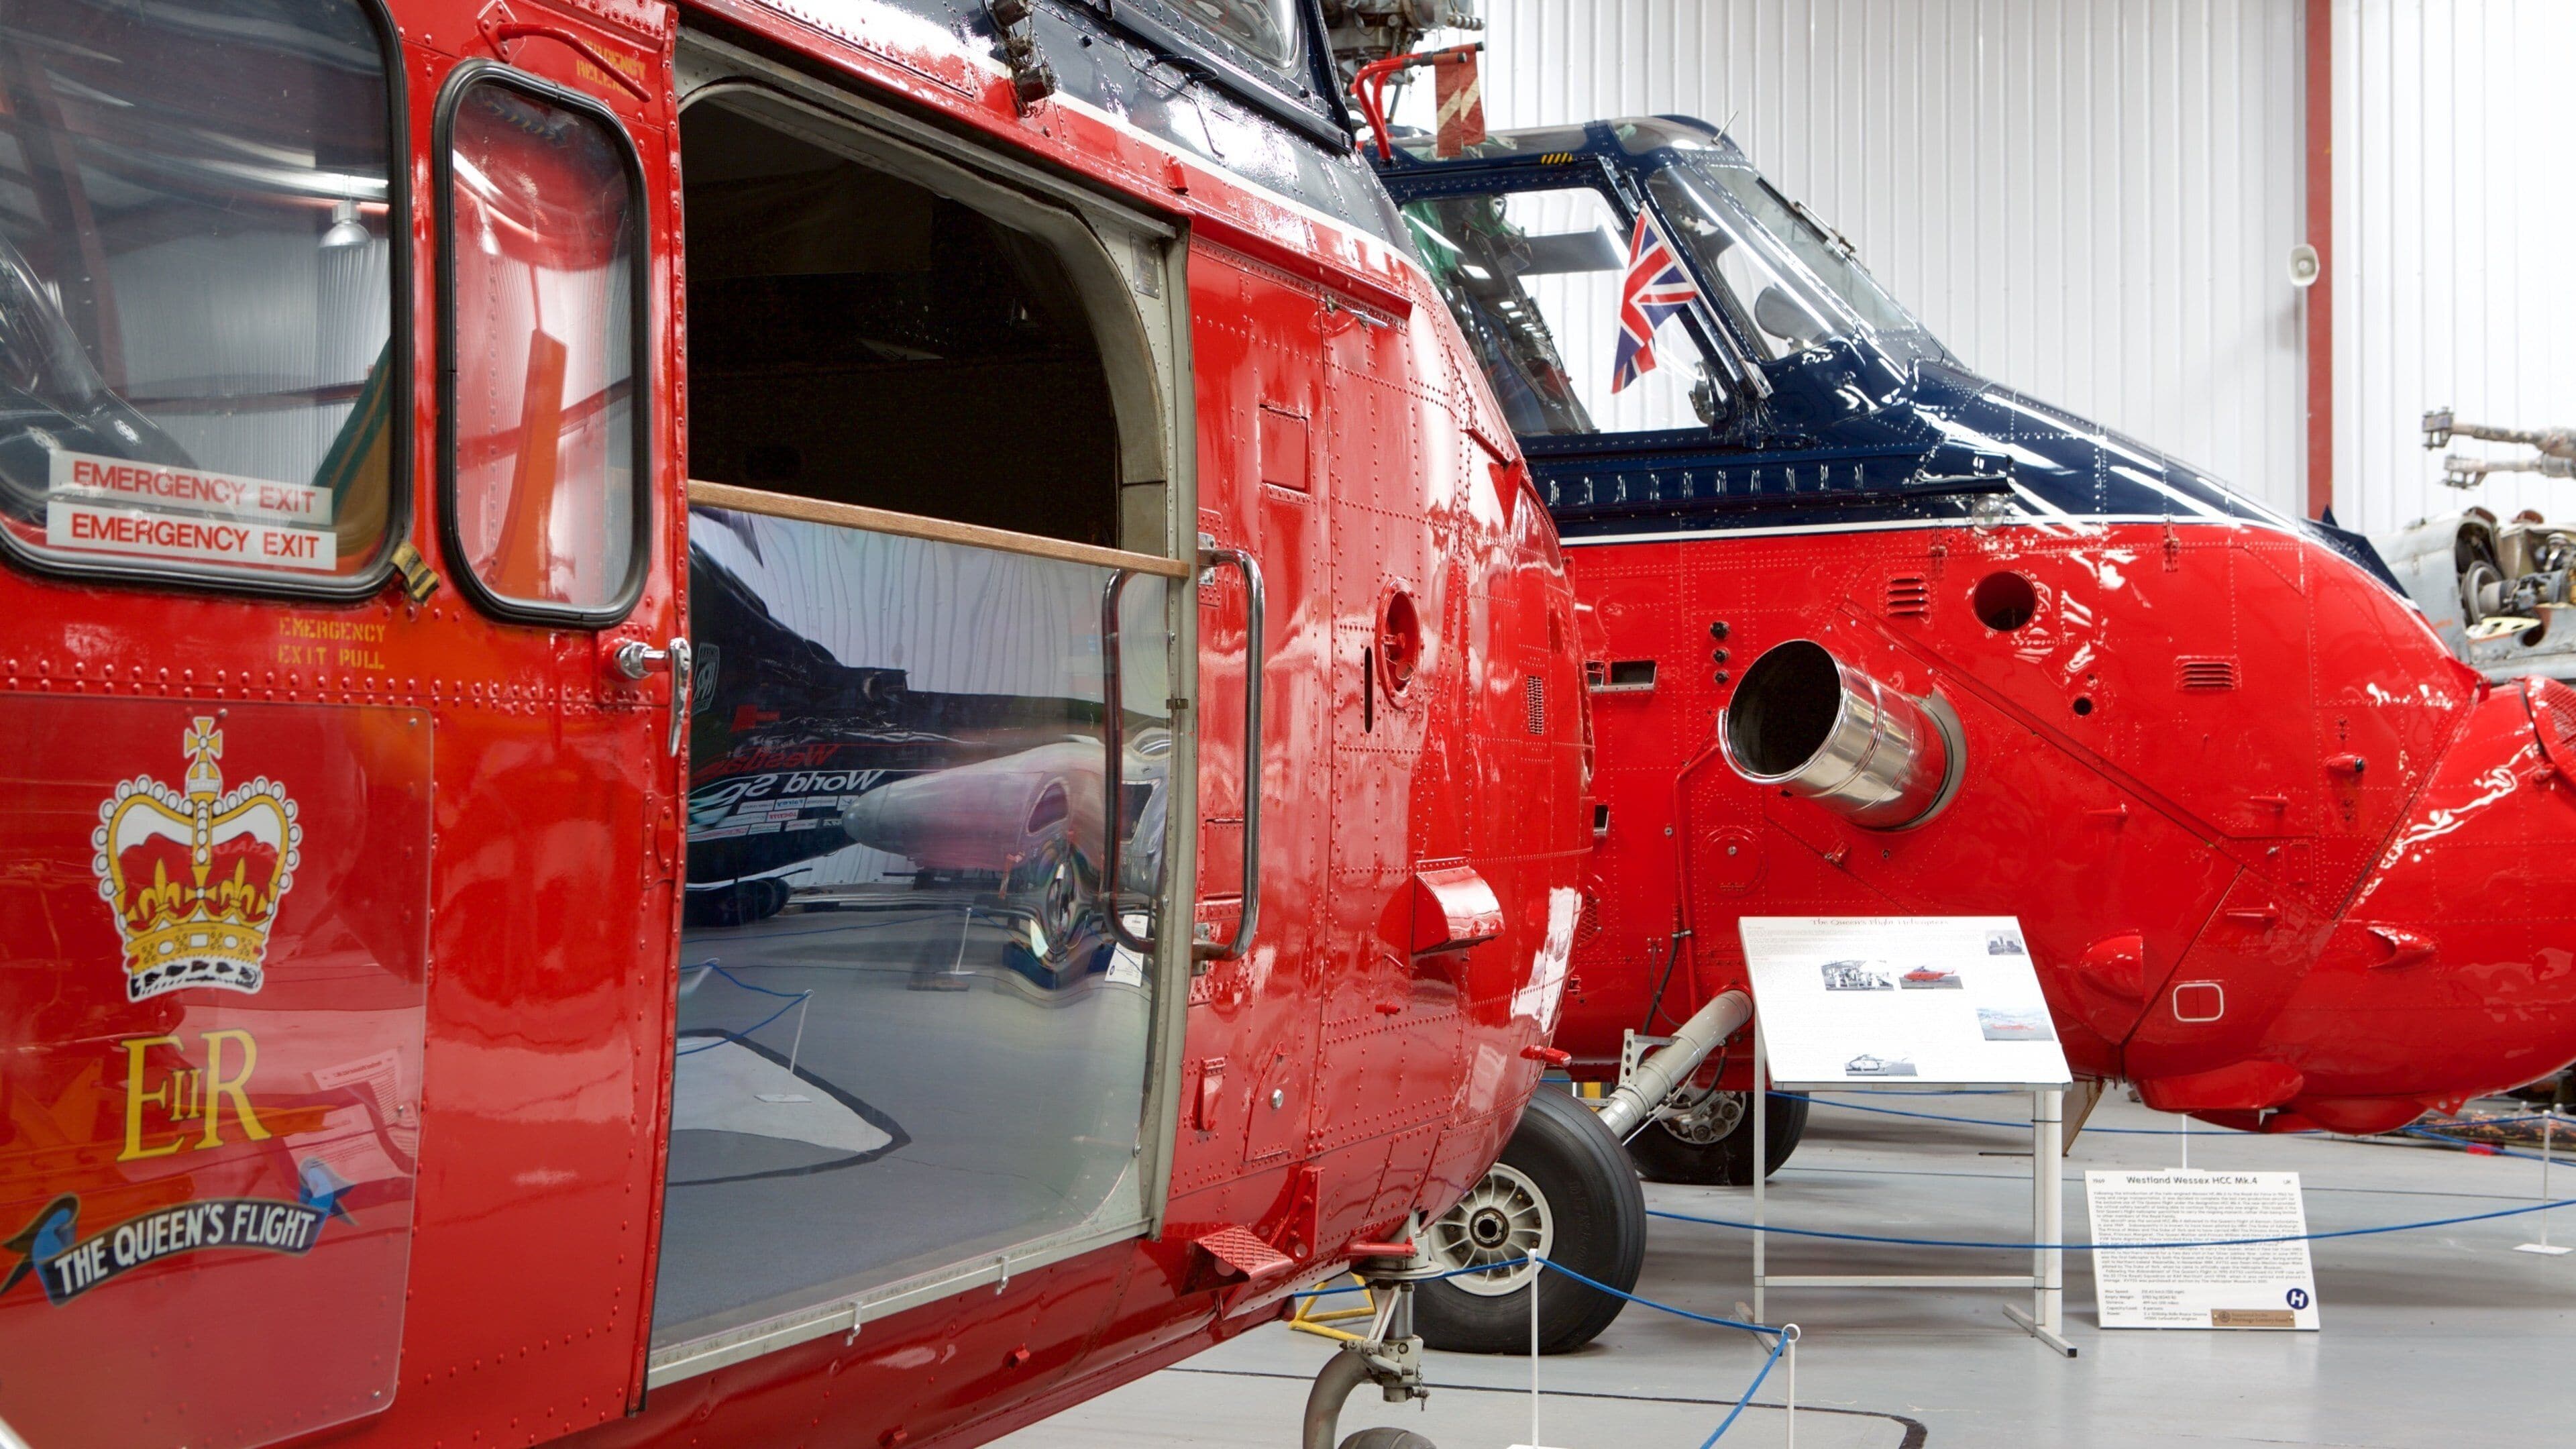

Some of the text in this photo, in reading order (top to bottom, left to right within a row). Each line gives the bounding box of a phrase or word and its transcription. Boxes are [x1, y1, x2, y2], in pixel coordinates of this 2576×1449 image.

[73, 461, 315, 515] EMERGENCY EXIT
[72, 513, 319, 558] EMERGENCY EXIT
[278, 616, 386, 643] EMERGENCY
[278, 644, 385, 669] EXIT PULL
[2126, 1176, 2258, 1185] Westland Wessex HCC Mk.4
[55, 1203, 316, 1295] THE QUEEN'S FLIGHT
